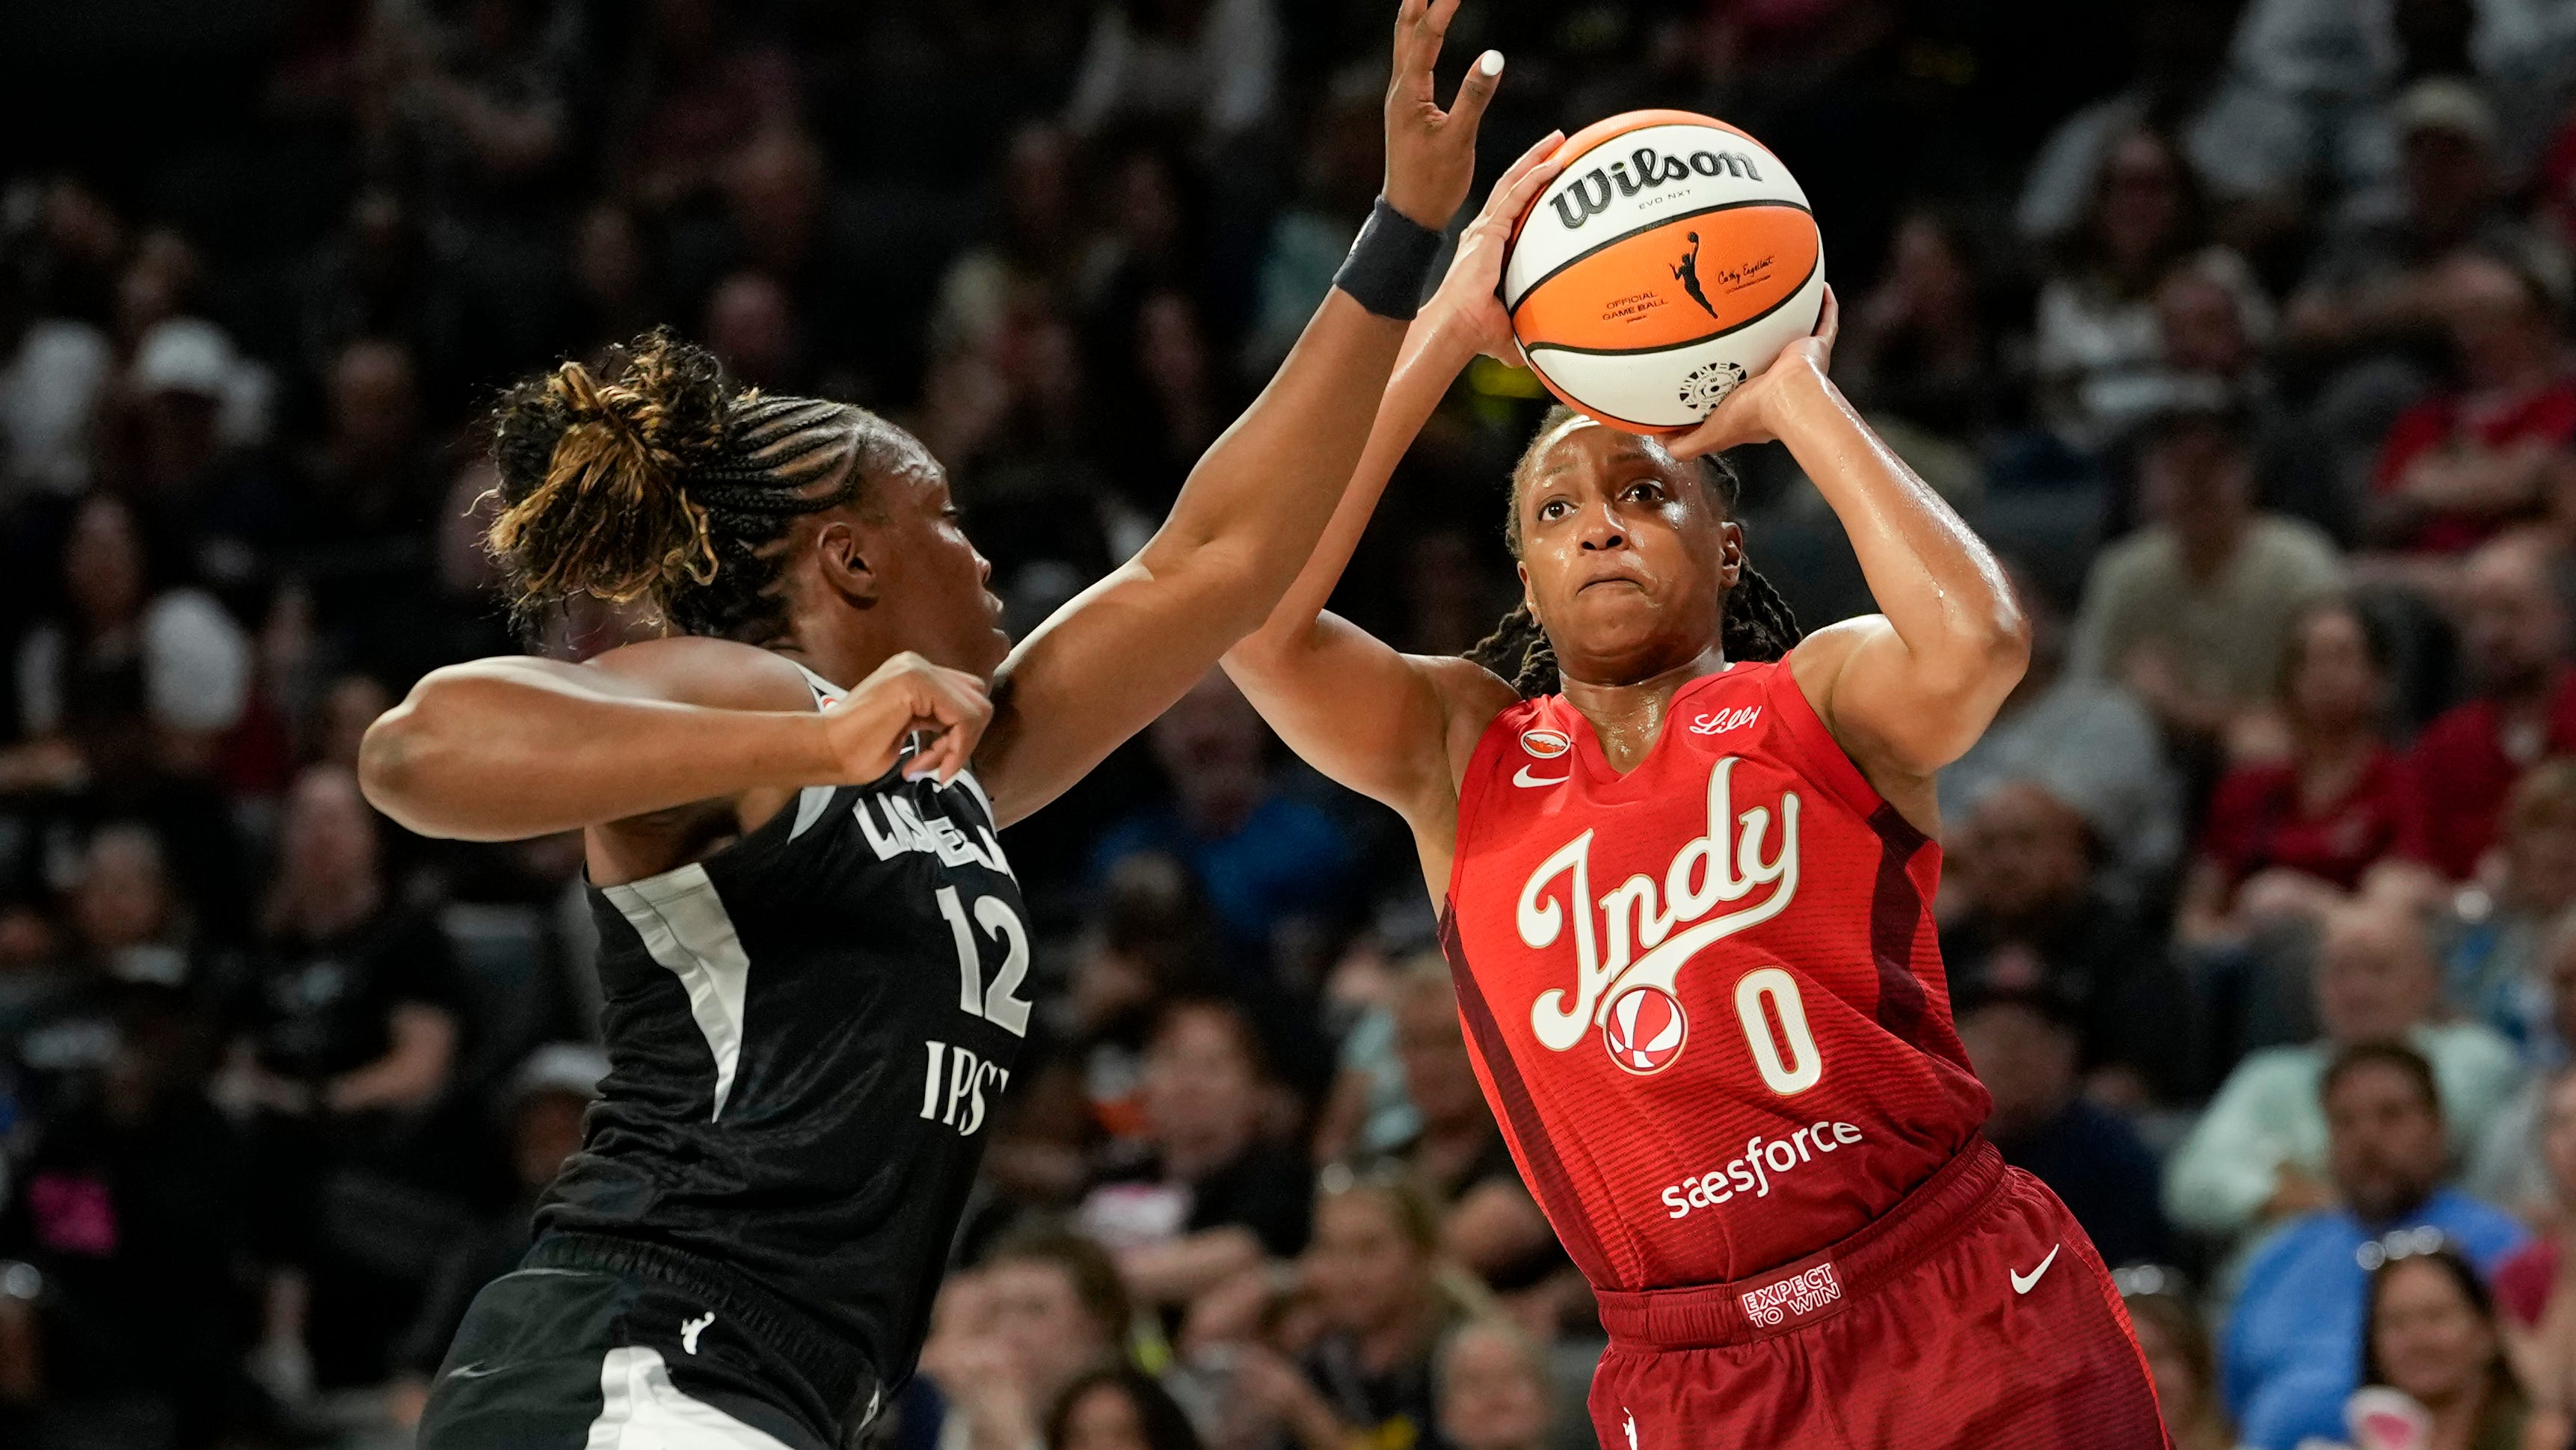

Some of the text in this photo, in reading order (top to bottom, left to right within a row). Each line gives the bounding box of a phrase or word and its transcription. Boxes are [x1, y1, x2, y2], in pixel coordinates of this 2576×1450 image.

[1548, 147, 1764, 230] Wilson
[1639, 189, 1691, 209] EVO NXT
[1602, 307, 1636, 321] GAME
[1637, 298, 1668, 312] BALL
[1606, 292, 1659, 310] OFFICIAL
[1688, 705, 1762, 735] Lilly
[1516, 755, 1801, 1051] Indy
[935, 885, 1033, 1039] 12
[1730, 965, 1823, 1096] 0
[1661, 1121, 1863, 1219] saesforce
[1742, 1262, 1833, 1315] EXPECT
[1749, 1282, 1842, 1328] TO WIN
